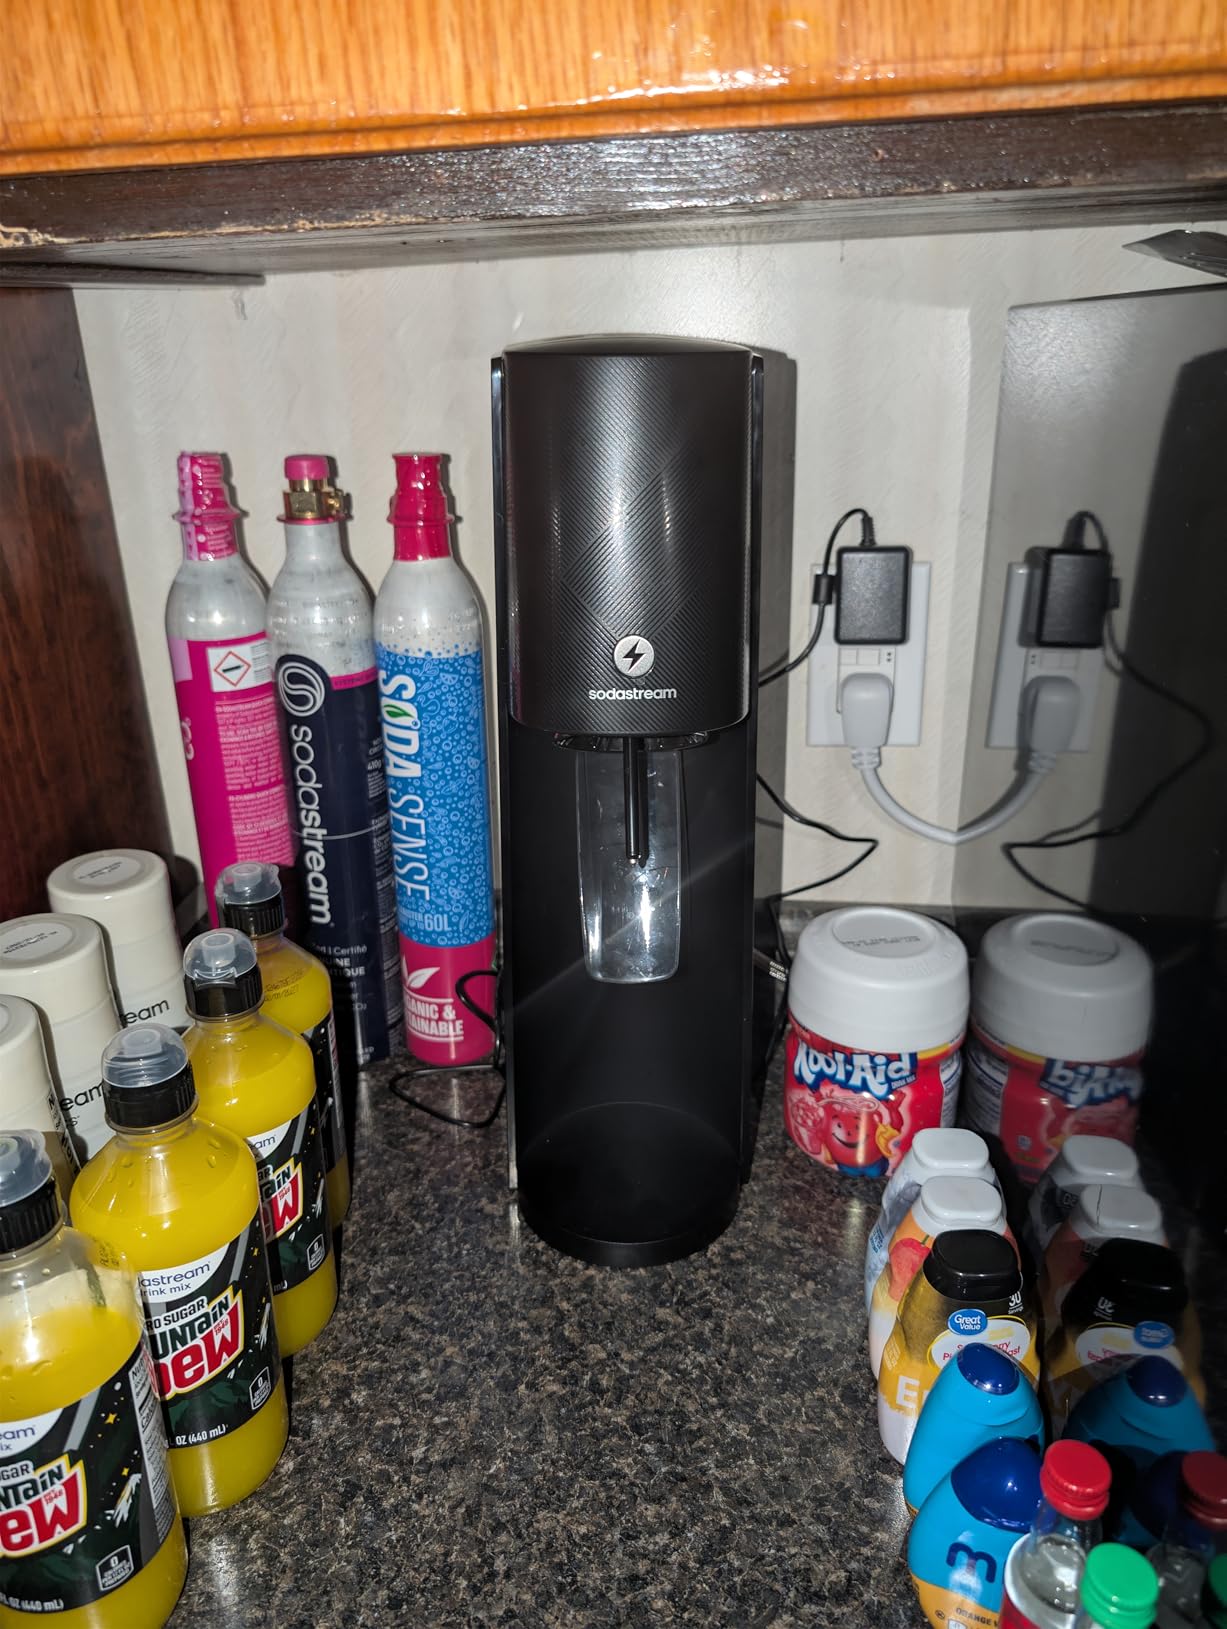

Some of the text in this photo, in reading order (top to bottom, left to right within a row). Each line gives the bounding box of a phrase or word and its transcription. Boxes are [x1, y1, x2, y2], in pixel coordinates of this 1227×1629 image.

[588, 687, 677, 700] sodastream
[378, 670, 422, 778] SODA
[290, 724, 332, 925] sodastream
[388, 788, 430, 901] SENSE
[424, 913, 452, 931] 60L
[442, 1004, 456, 1020] &
[794, 1040, 912, 1097] Kool-Aid
[169, 1283, 191, 1294] mix
[954, 1313, 981, 1325] Great
[960, 1323, 981, 1331] Value
[176, 1423, 226, 1446] OZ (440 mL)
[956, 1607, 992, 1626] ORANGE
